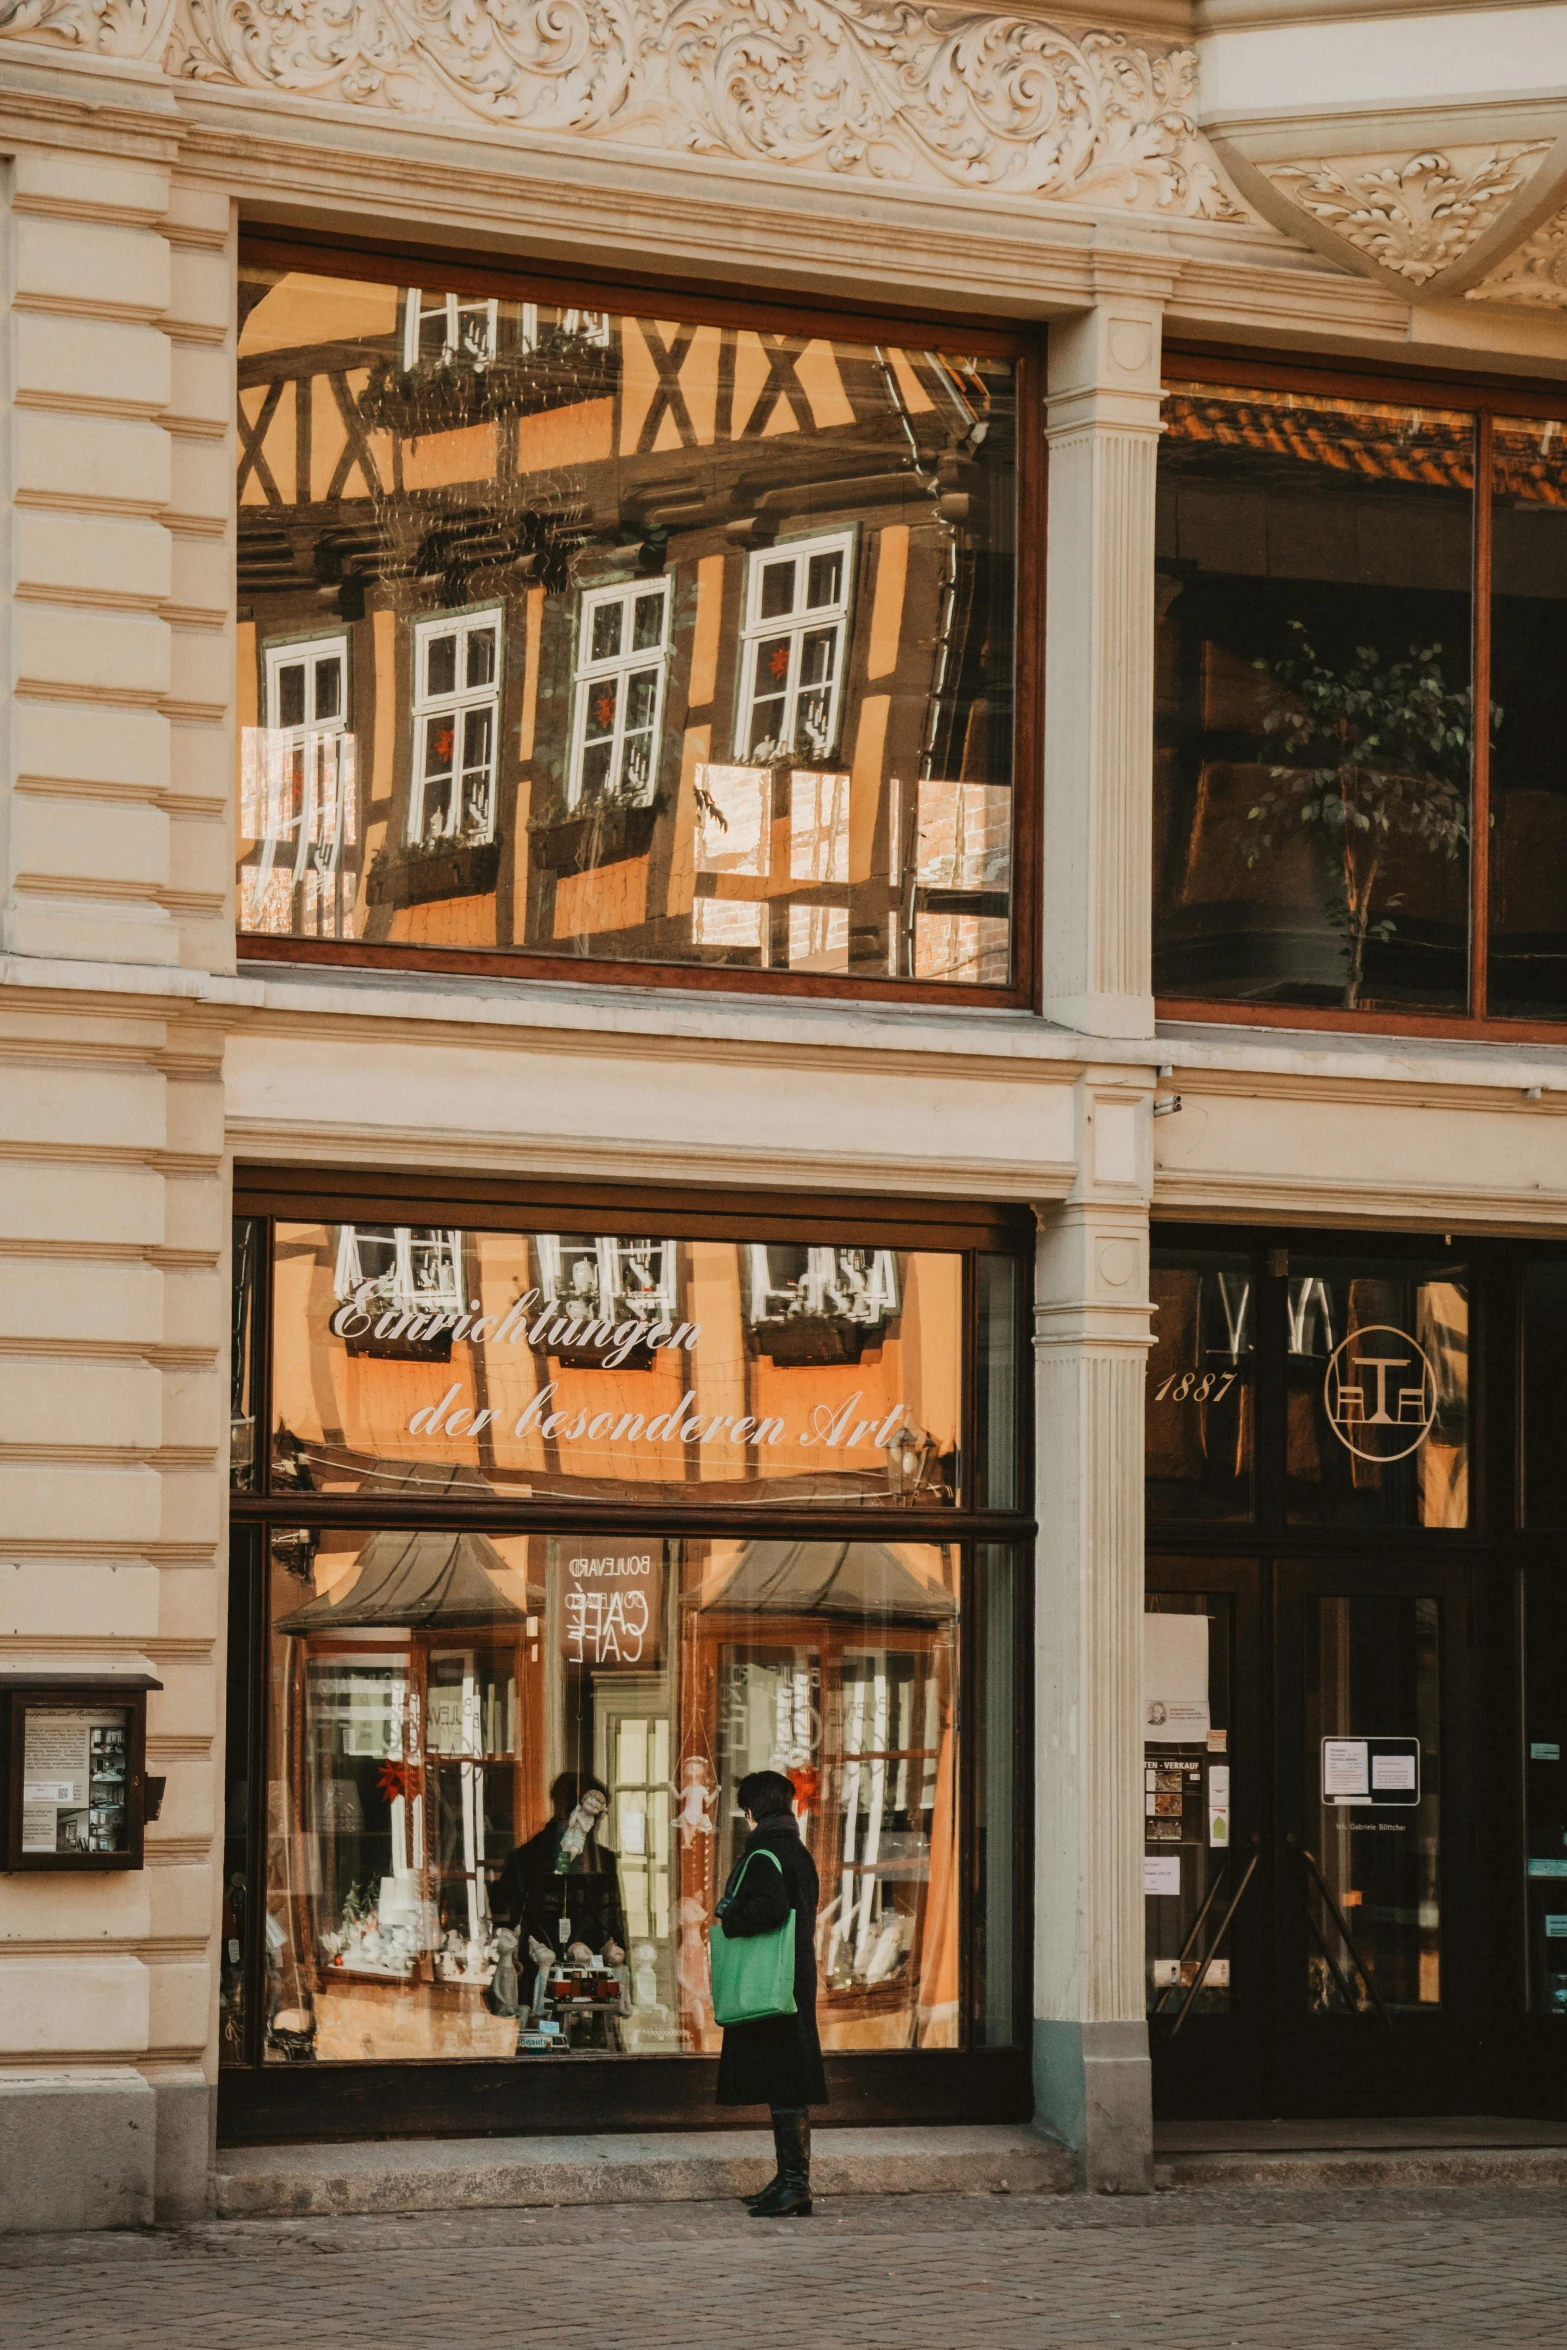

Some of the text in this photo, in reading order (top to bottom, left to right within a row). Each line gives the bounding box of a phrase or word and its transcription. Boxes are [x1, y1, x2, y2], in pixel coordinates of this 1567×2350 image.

[332, 1281, 703, 1370] Einrichtungen
[1155, 1371, 1238, 1402] 1887
[408, 1381, 908, 1450] der besonderen Art
[1164, 1761, 1199, 1770] VERKAUF
[1349, 1822, 1377, 1831] Gabriele
[1379, 1823, 1407, 1832] Böttcher
[520, 2038, 548, 2047] Beauty
